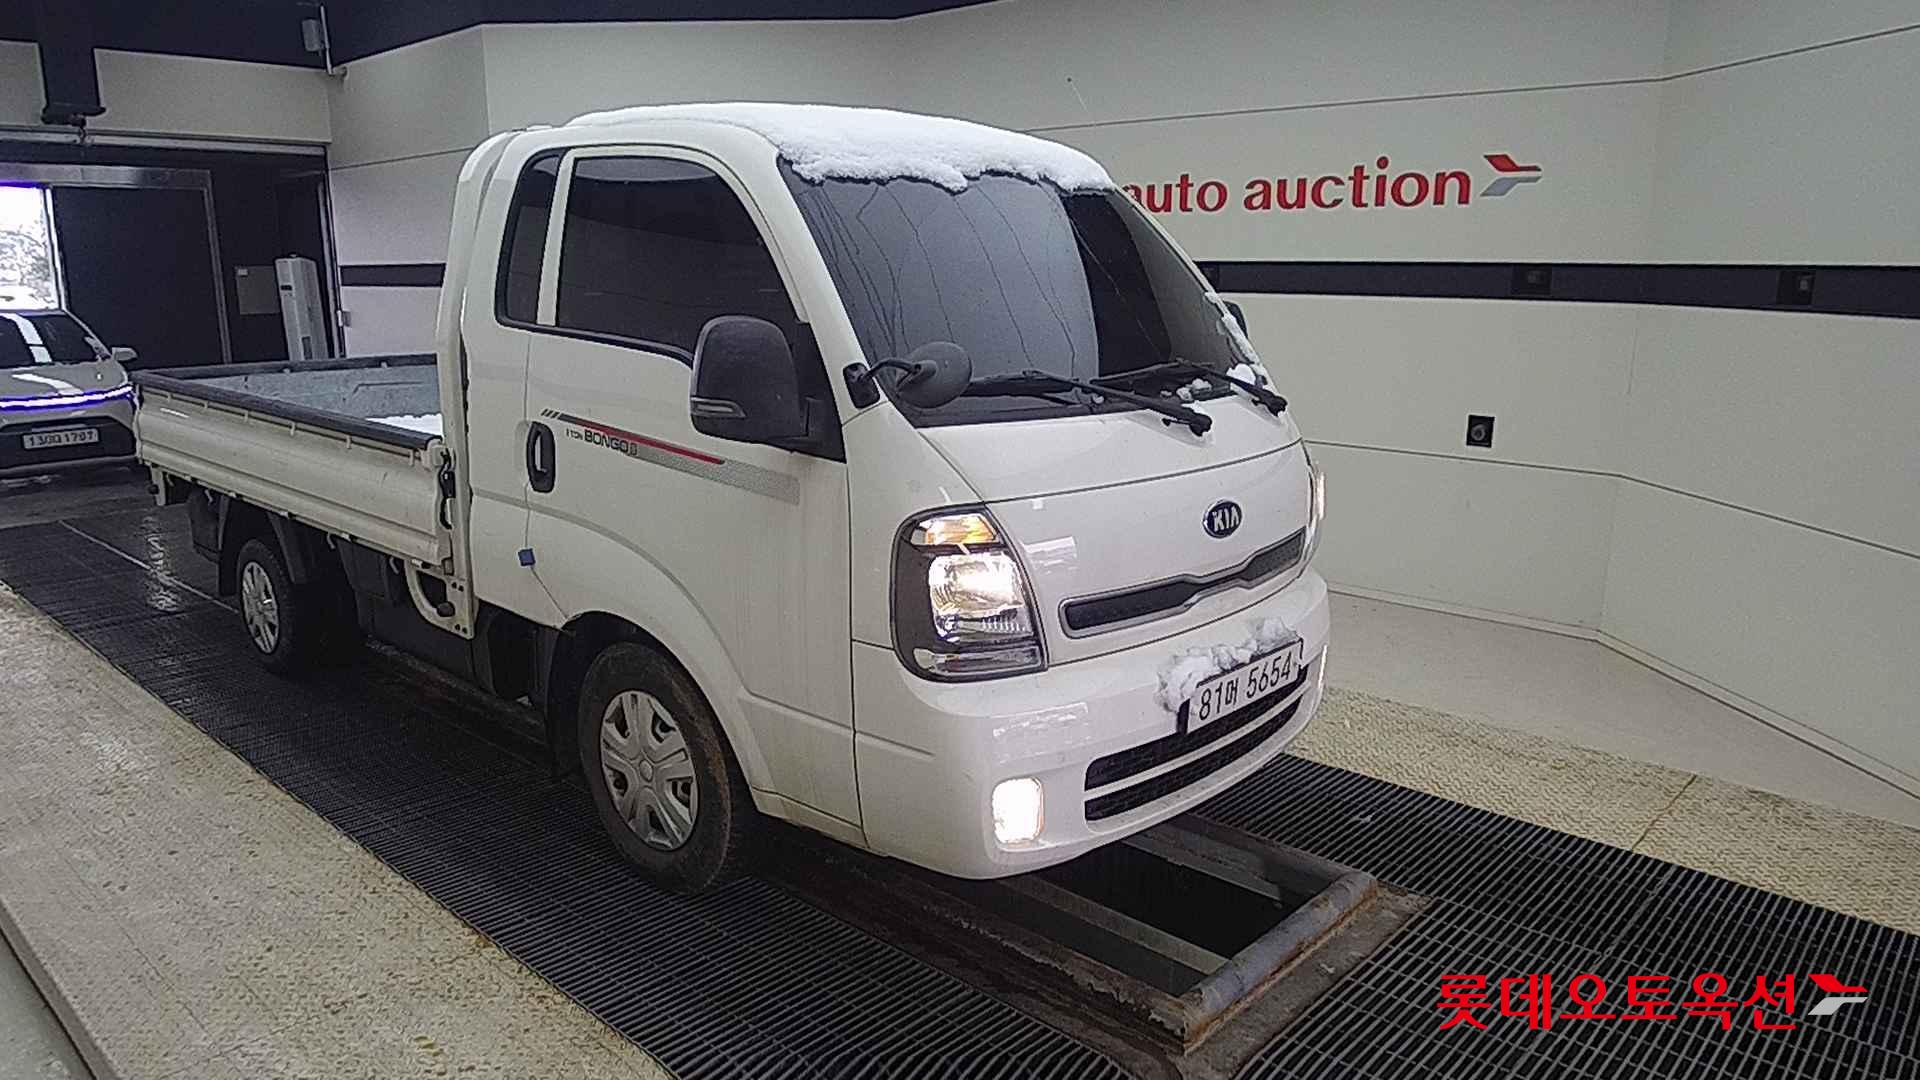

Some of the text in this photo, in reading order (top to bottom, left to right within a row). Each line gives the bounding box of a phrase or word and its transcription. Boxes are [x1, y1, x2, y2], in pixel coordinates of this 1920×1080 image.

[1243, 155, 1472, 211] auction
[1212, 506, 1240, 533] KIA
[1199, 651, 1292, 721] 81머 5654
